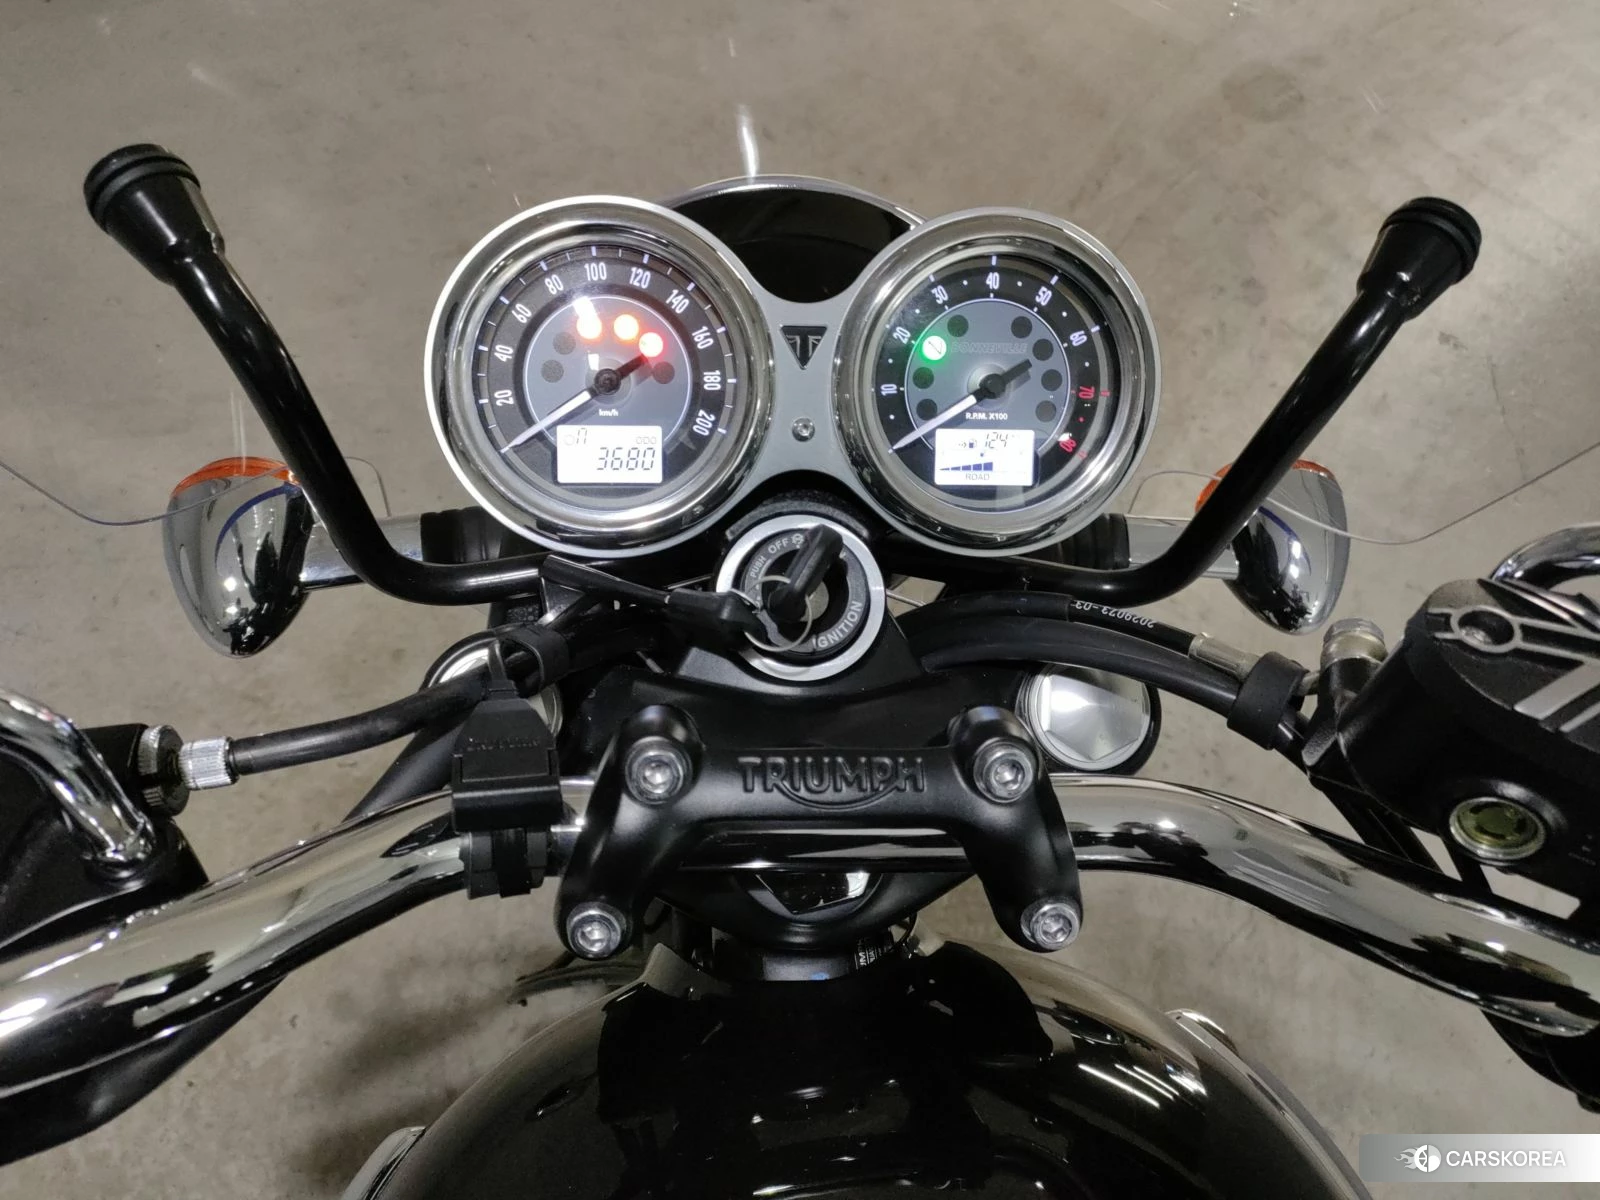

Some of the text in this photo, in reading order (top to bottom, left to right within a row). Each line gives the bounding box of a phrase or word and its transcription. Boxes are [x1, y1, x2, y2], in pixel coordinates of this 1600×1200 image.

[584, 262, 607, 281] 100
[629, 266, 651, 289] 120
[985, 272, 1000, 290] 40
[544, 274, 564, 295] 80
[931, 285, 949, 304] 30
[665, 289, 690, 314] 140
[1035, 286, 1052, 306] 50
[511, 303, 532, 324] 60
[691, 326, 714, 350] 160
[892, 326, 911, 344] 20
[1069, 330, 1088, 347] 60
[494, 344, 514, 362] 40
[703, 369, 721, 391] 180
[880, 383, 898, 396] 10
[494, 389, 514, 406] 20
[1078, 385, 1095, 399] 70
[599, 408, 619, 417] km/h
[692, 409, 716, 436] 200
[596, 447, 656, 471] 3680
[965, 473, 990, 481] ROAD
[750, 538, 789, 578] PUSH OFF
[811, 600, 863, 649] IGNITION
[737, 756, 927, 802] TRIUMPH
